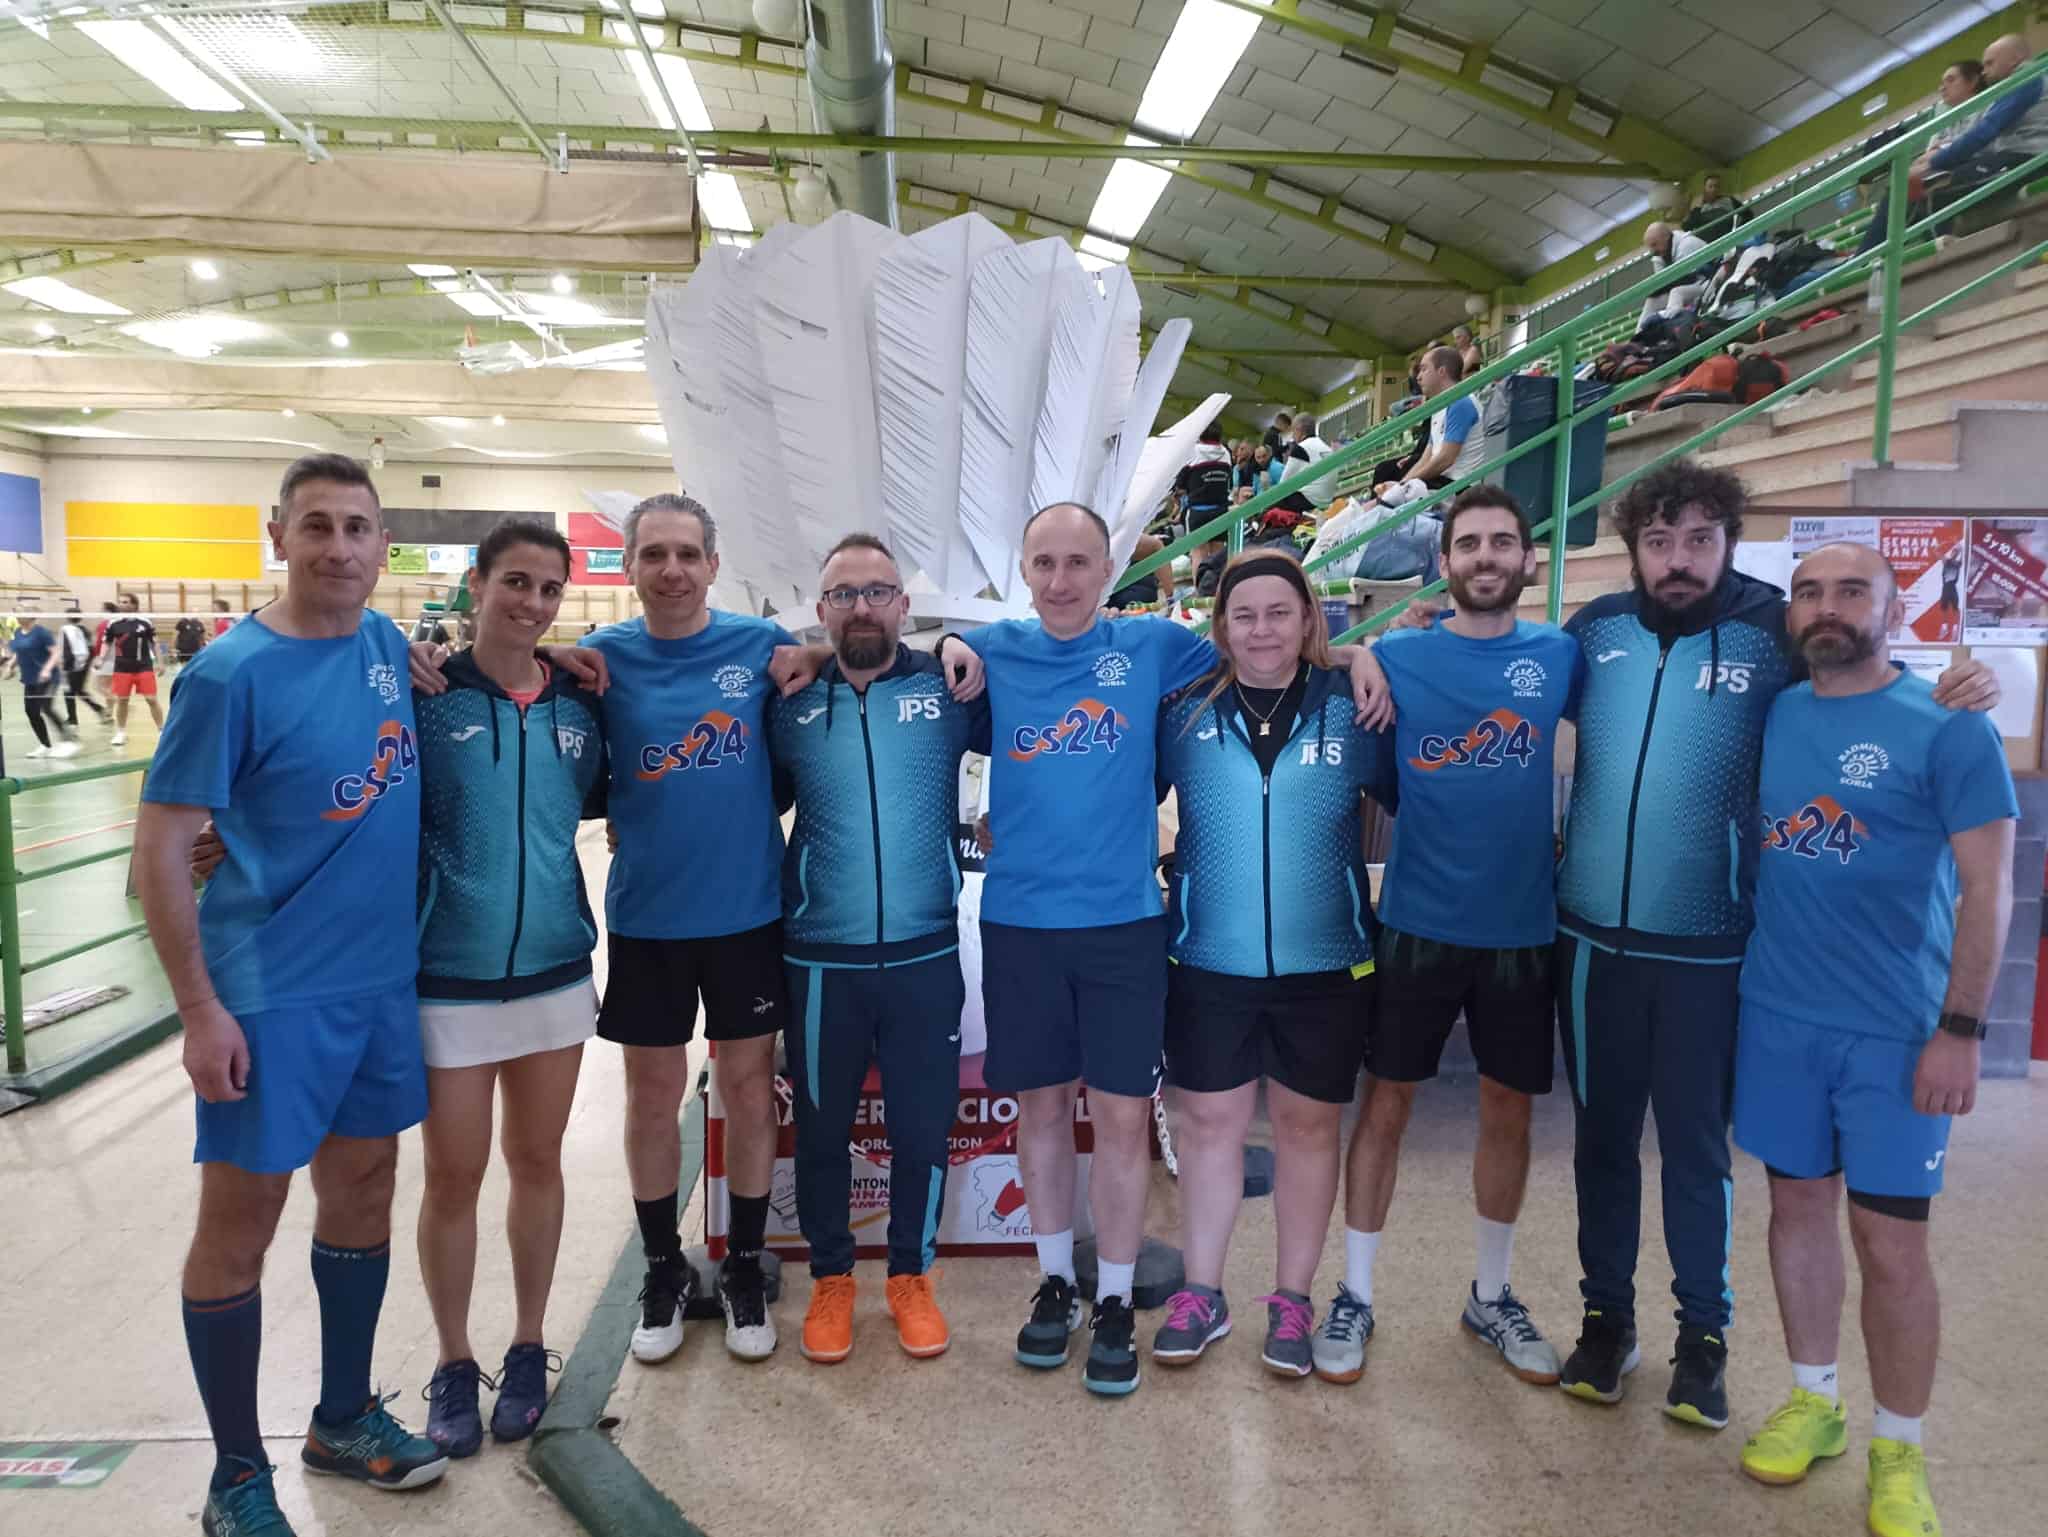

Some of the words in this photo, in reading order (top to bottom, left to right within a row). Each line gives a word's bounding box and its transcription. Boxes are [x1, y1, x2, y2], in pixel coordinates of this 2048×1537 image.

[1882, 536, 1939, 548] SEMANA
[1882, 546, 1929, 558] SANTA
[897, 697, 942, 722] JPS
